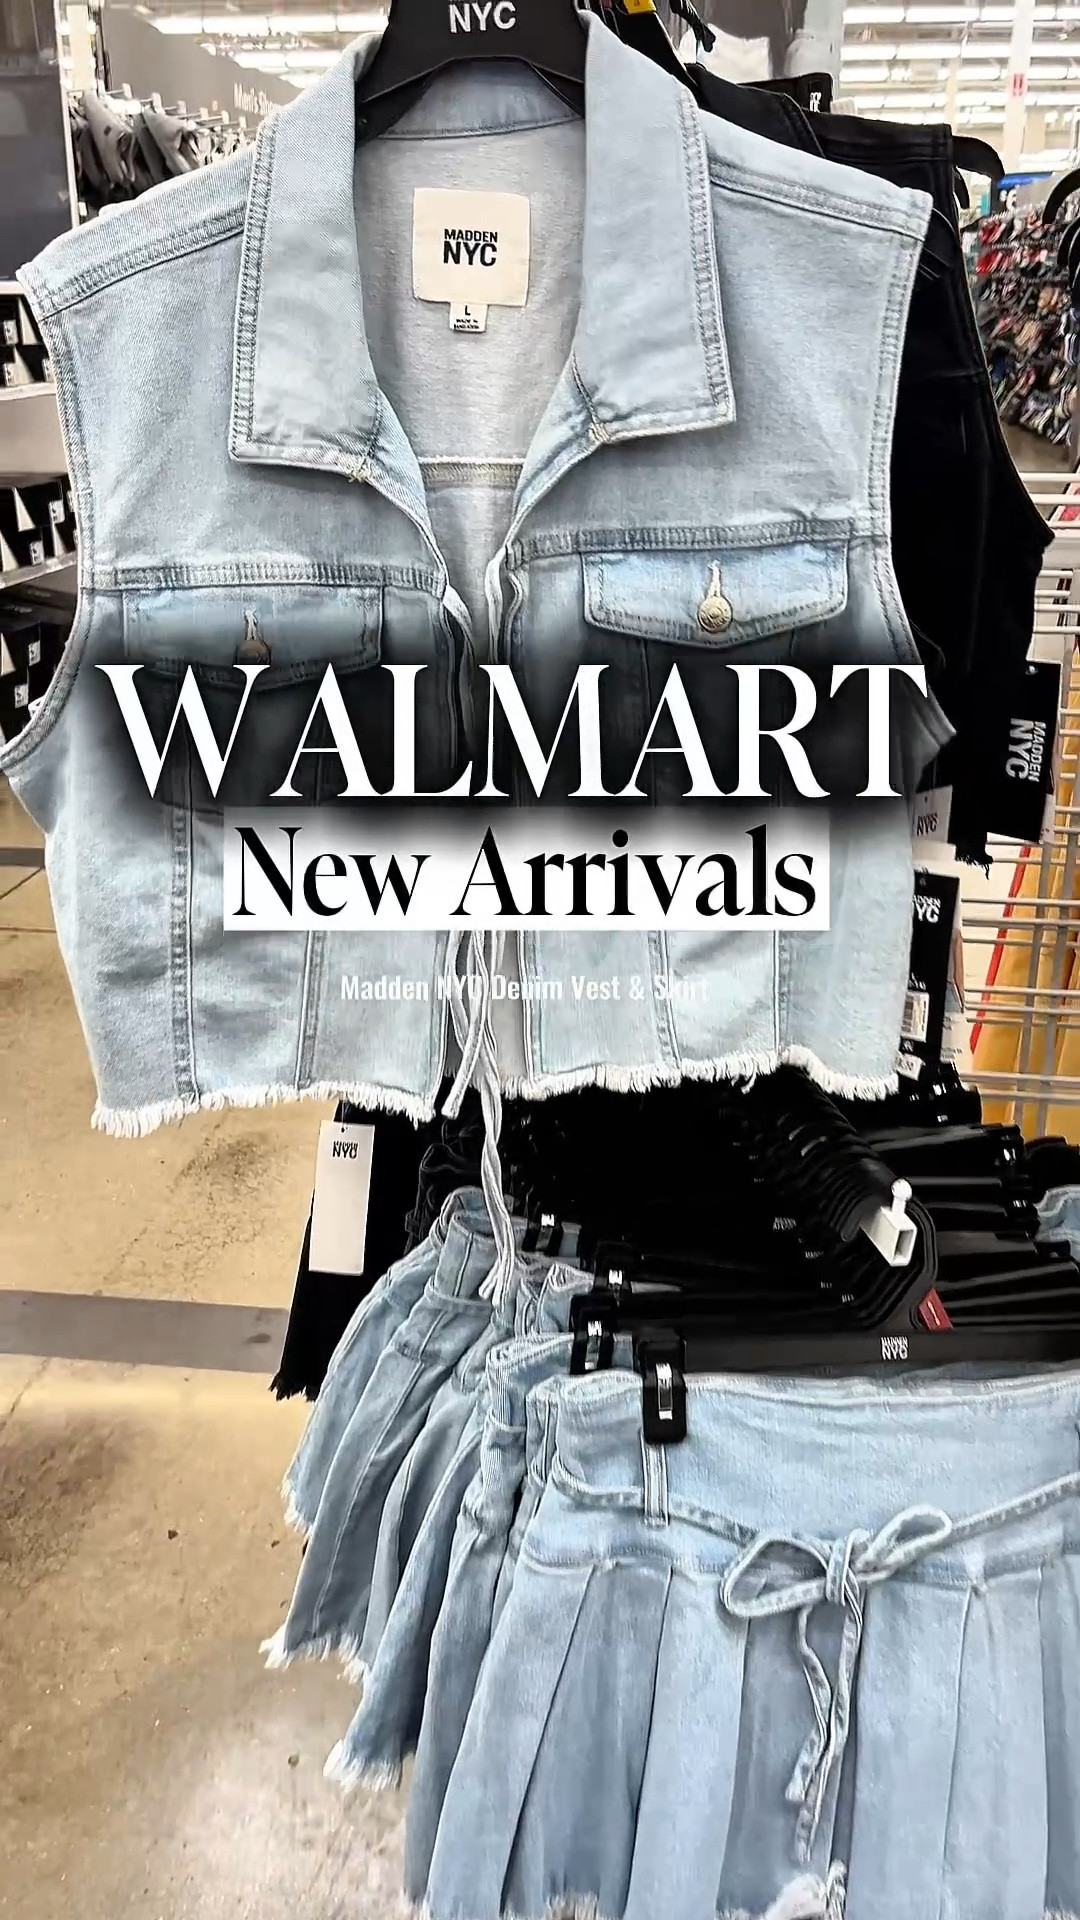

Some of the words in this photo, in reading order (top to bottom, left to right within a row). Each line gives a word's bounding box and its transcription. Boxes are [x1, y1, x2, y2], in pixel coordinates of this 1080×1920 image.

[449, 1, 516, 33] NYC
[444, 228, 498, 243] MADDEN
[443, 240, 498, 267] NYC
[464, 304, 471, 316] L
[1005, 717, 1034, 779] NYC
[1028, 720, 1046, 782] MADDEN
[912, 902, 940, 923] YC
